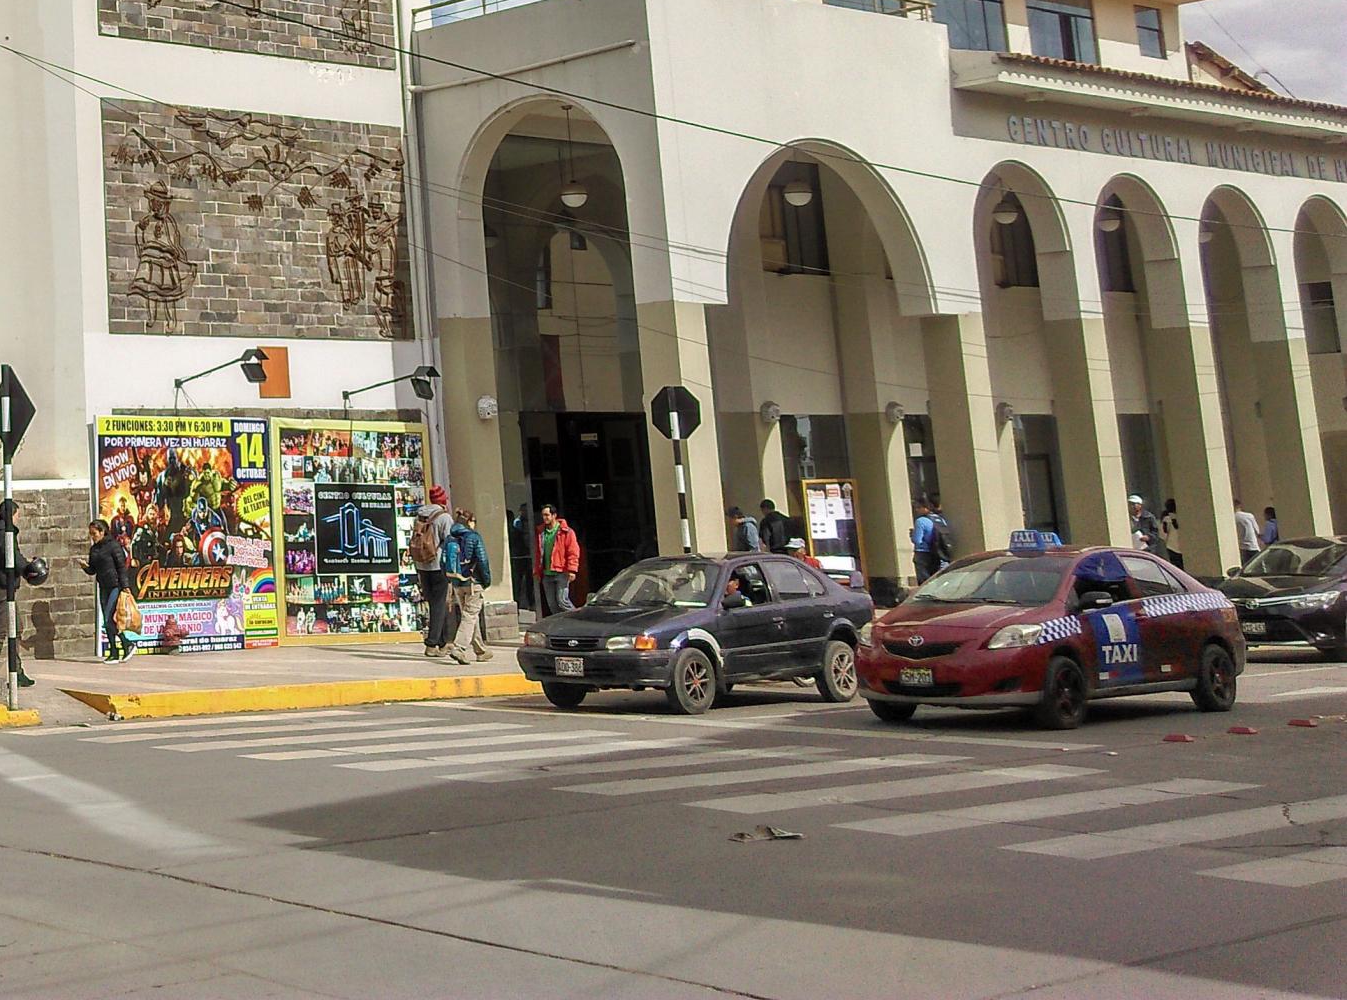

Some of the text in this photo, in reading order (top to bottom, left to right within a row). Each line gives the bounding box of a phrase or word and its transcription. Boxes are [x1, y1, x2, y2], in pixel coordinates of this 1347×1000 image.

[1007, 115, 1088, 151] CENTRO
[1101, 128, 1198, 163] CULTURAL
[1305, 155, 1327, 180] DE
[105, 420, 224, 432] 2 FUNCIONES: 3:30 PM Y 6:30 PM
[233, 422, 265, 433] DOMINGO
[104, 437, 227, 447] POR PRIMERA VEZ EN HUARAZ
[235, 433, 265, 468] 14
[102, 450, 129, 473] SHOW
[103, 463, 138, 490] EN VIVO
[236, 468, 267, 479] OCTUBRE
[243, 490, 266, 504] DEL CINE
[351, 492, 392, 500] CULTURAL
[250, 499, 270, 511] TEATRO
[1012, 531, 1036, 543] TAXI
[137, 560, 233, 599] AVENGERS
[148, 589, 227, 599] INFINITY WAR
[144, 625, 155, 635] DE
[1101, 644, 1138, 665] TAXI
